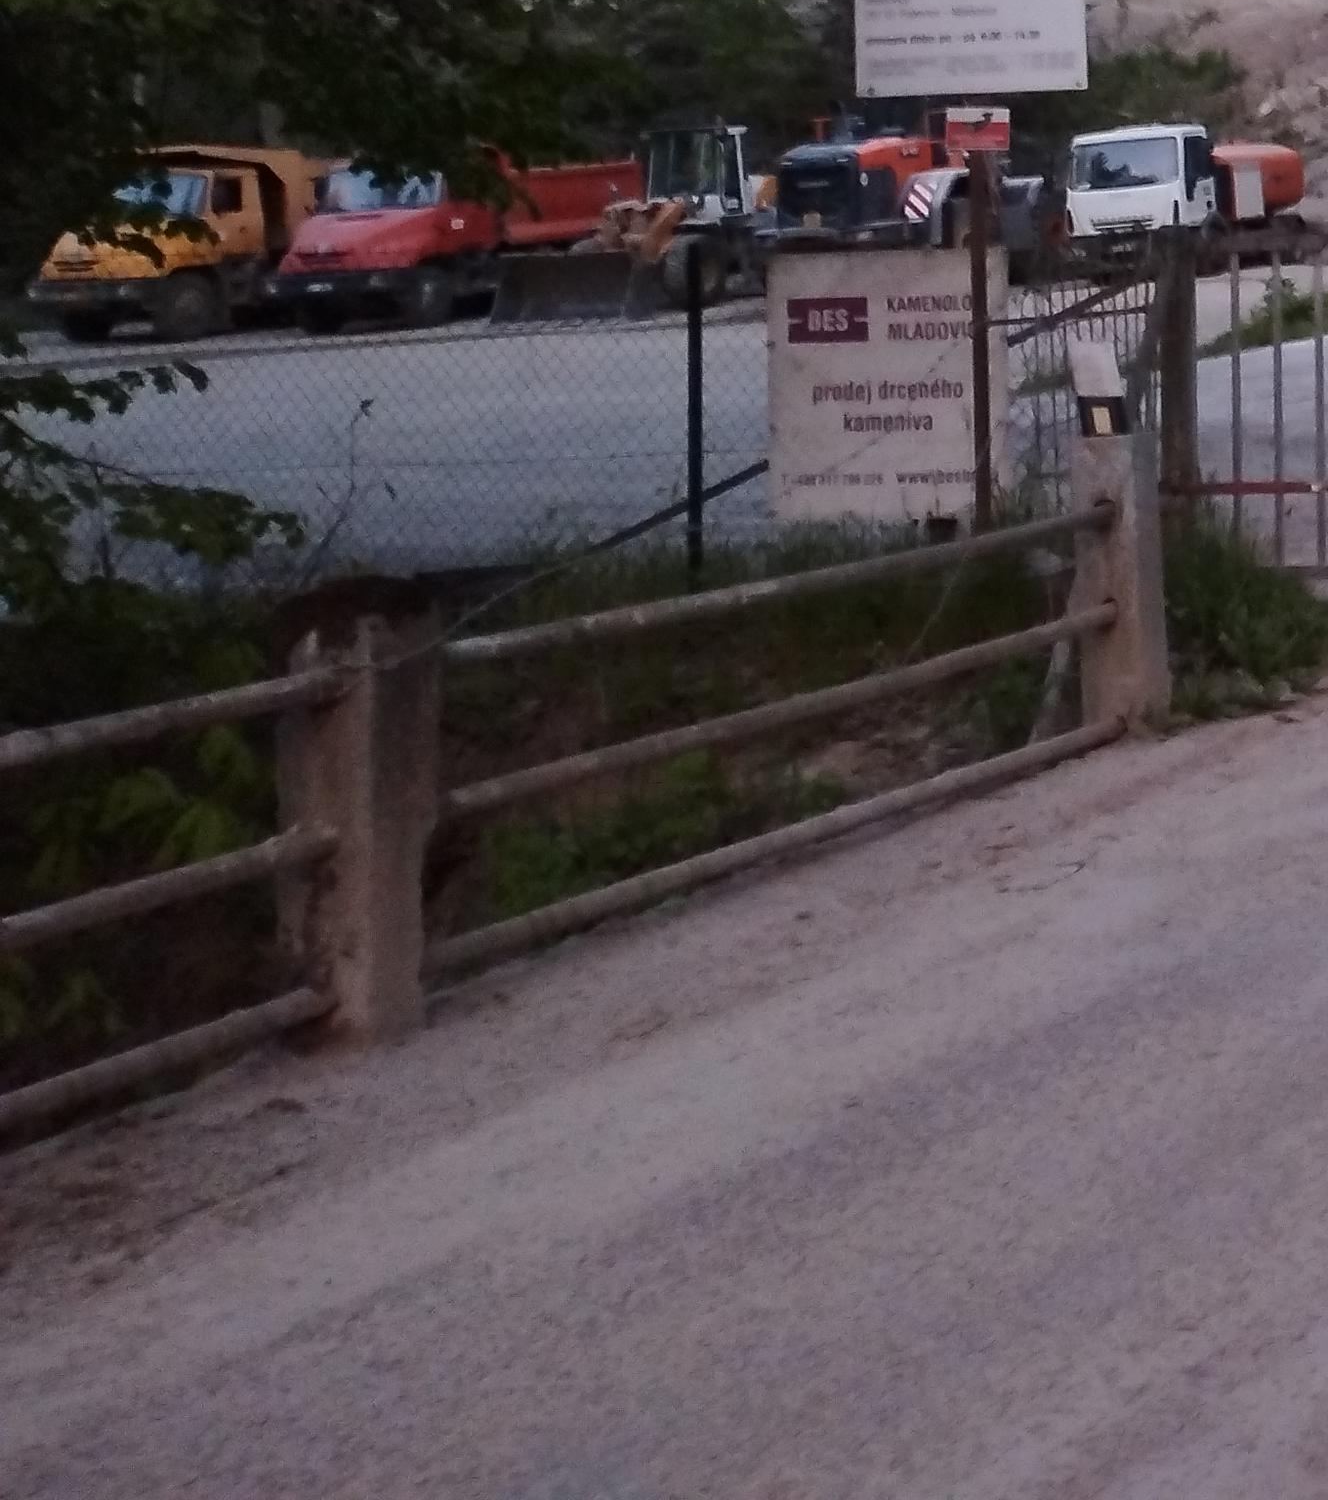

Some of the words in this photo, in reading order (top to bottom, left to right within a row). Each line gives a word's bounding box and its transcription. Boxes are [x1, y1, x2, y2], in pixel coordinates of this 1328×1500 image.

[886, 295, 973, 313] KAMENOLO
[887, 322, 974, 342] MLADOVIC
[812, 380, 872, 404] prodej
[878, 378, 964, 400] drceného
[843, 412, 933, 432] kameniva
